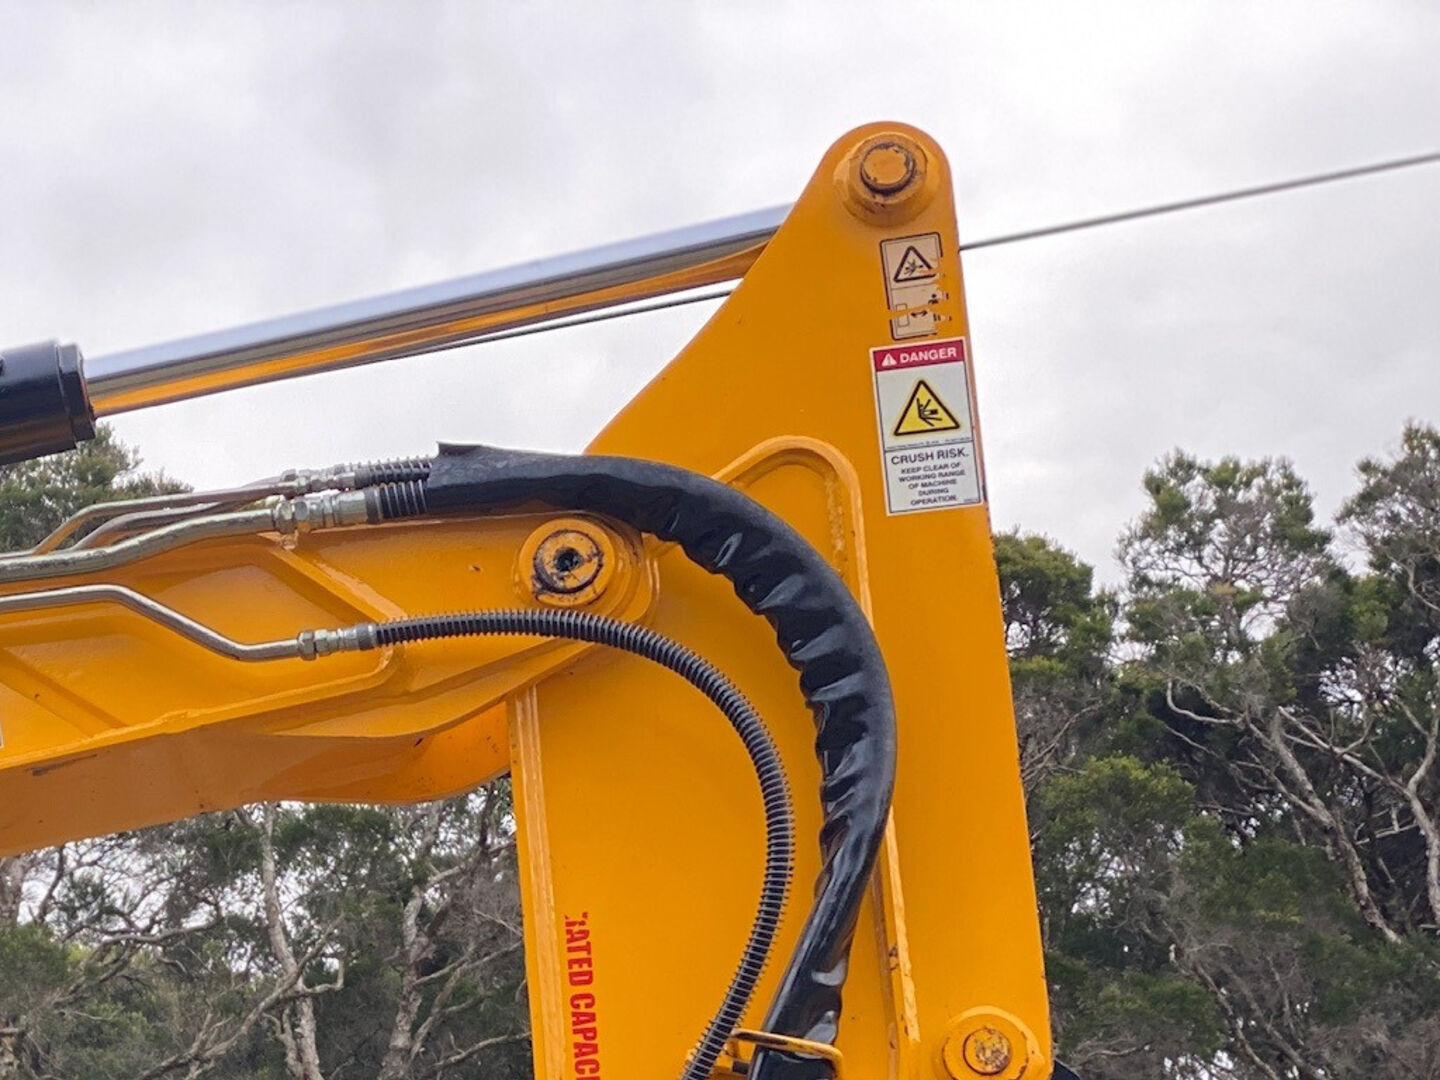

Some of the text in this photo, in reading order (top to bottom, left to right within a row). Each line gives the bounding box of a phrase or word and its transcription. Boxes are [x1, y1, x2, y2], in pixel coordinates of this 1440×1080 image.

[900, 347, 957, 364] DANGER
[890, 446, 969, 466] CRUSH RISK.
[900, 461, 961, 475] KEEP CLEAR OF
[898, 469, 965, 483] WORKING RANGE
[907, 478, 957, 490] OF MACHINE
[918, 487, 949, 497] DURING
